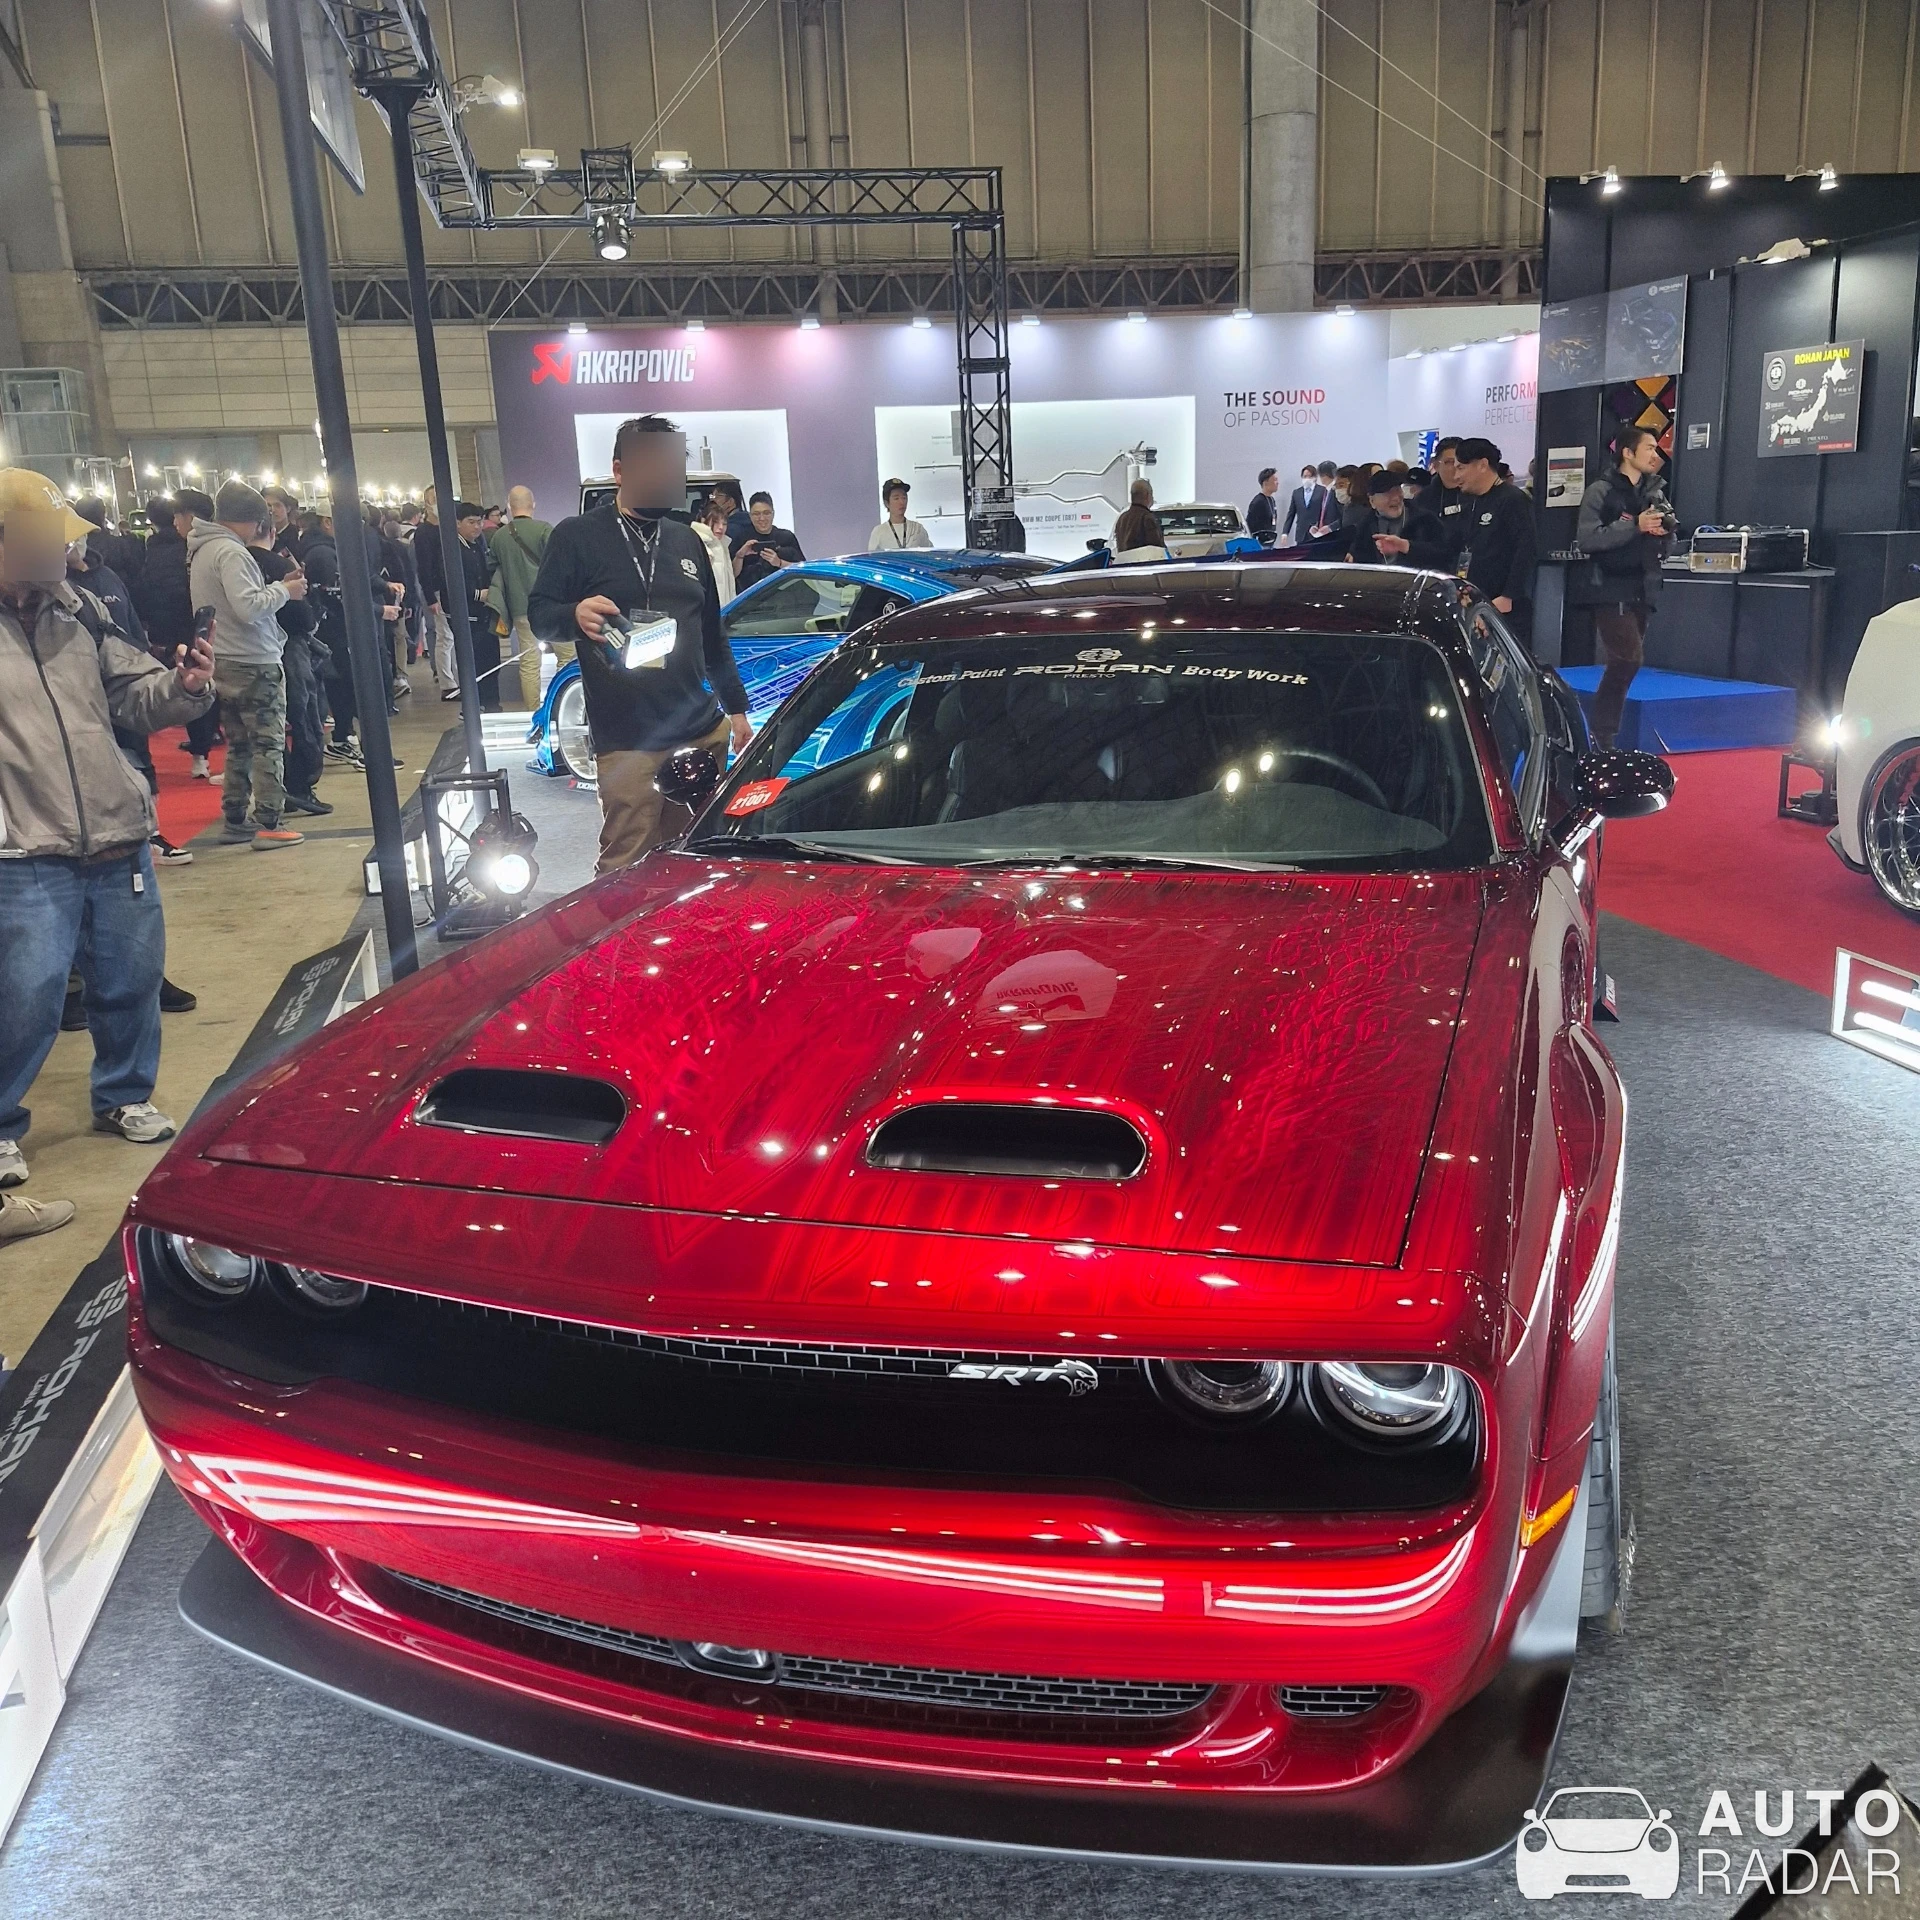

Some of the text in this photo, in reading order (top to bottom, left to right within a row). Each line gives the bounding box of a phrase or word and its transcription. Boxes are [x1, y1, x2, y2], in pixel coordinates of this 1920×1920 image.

[1794, 347, 1850, 365] ROHAN JAPAN
[1223, 389, 1325, 408] THE SOUND
[1485, 382, 1537, 404] PERFORM
[1223, 408, 1320, 428] OF PASSION
[1484, 403, 1537, 426] PERFECTE
[898, 664, 1308, 688] Custom Paint ROHAN Body Work
[730, 792, 773, 811] 21001
[278, 978, 320, 1036] ROHAN
[949, 1364, 1068, 1386] SRT
[4, 1410, 27, 1432] ART
